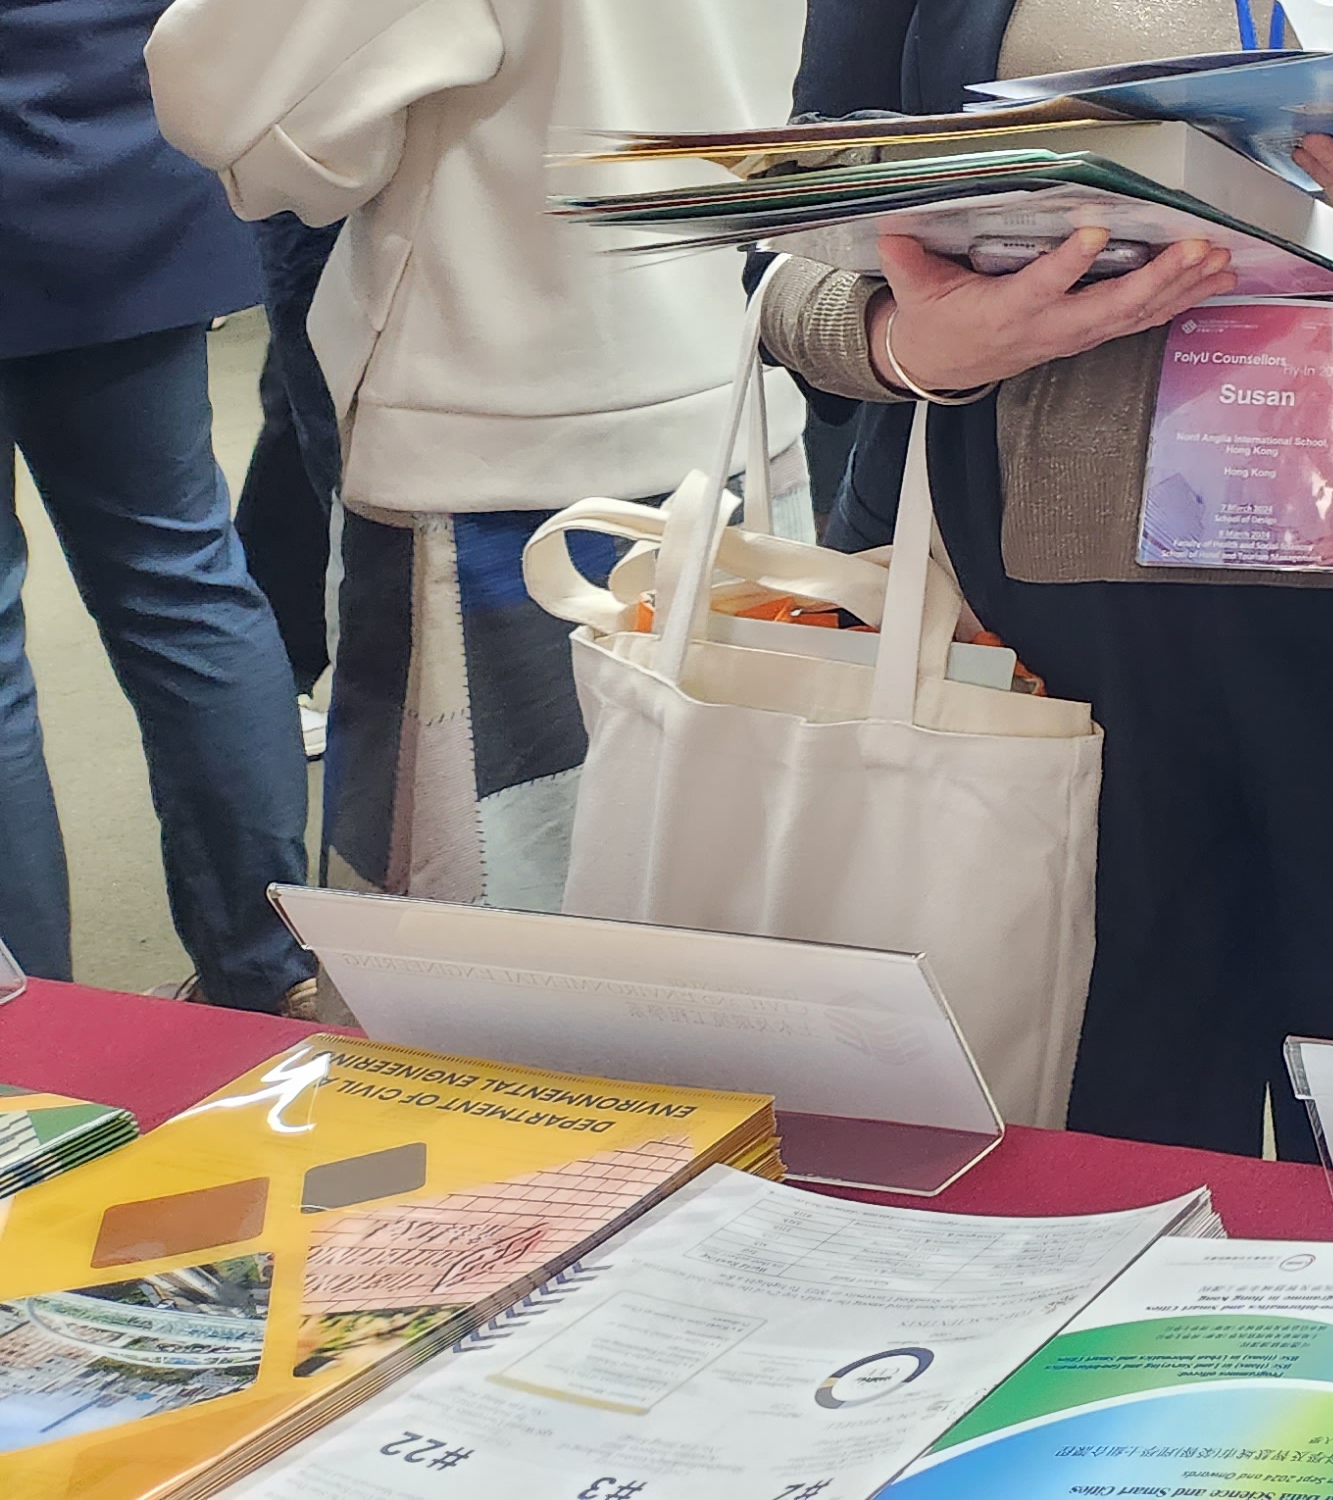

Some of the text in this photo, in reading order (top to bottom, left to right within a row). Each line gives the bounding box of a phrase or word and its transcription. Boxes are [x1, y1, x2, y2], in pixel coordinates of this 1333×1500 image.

[1173, 351, 1287, 367] PolyU Counsellors
[1283, 364, 1315, 377] Fly-In
[1219, 383, 1296, 407] Susan
[1201, 433, 1232, 445] Anglia
[1233, 433, 1293, 446] International
[1226, 446, 1279, 458] Hong Kong
[1224, 467, 1277, 479] Hong Kong
[1214, 514, 1277, 526] School of Design
[336, 1076, 402, 1102] CIVIL
[398, 1091, 440, 1108] OF
[481, 1076, 698, 1120] ENVIRONMENTAL
[434, 1098, 616, 1135] DEPARTMENT
[1232, 1295, 1266, 1303] Hong
[1221, 1305, 1246, 1313] and
[1044, 1363, 1121, 1371] Geo-Informatics
[1145, 1362, 1193, 1370] Surveying
[1233, 1362, 1271, 1370] (Hons)
[380, 1431, 475, 1472] #22
[1181, 1470, 1237, 1479] Onwards
[1239, 1472, 1263, 1480] and
[1296, 1475, 1327, 1485] Sept
[577, 1477, 648, 1500] #3
[1068, 1485, 1115, 1496] Cities
[1118, 1486, 1171, 1497] Smart
[1174, 1487, 1207, 1498] and
[1210, 1489, 1276, 1500] Science
